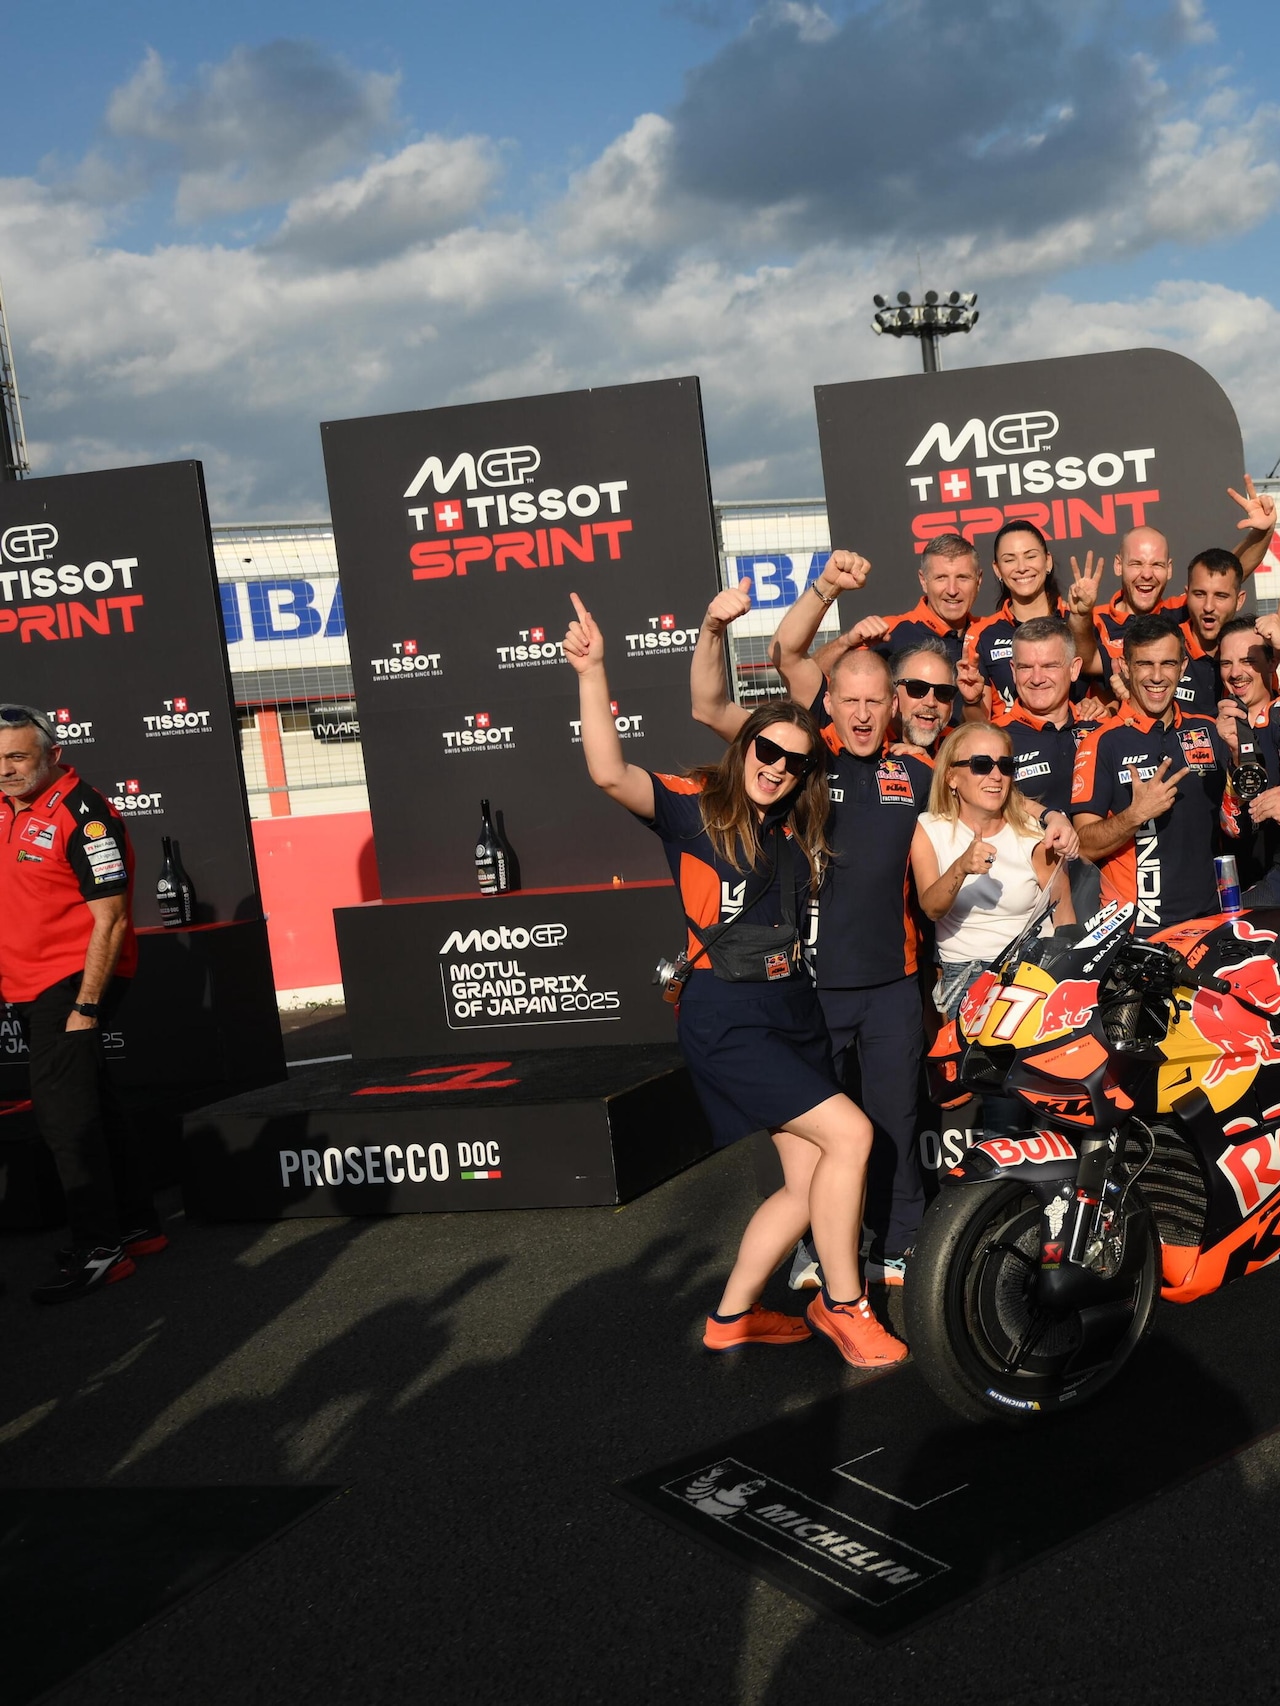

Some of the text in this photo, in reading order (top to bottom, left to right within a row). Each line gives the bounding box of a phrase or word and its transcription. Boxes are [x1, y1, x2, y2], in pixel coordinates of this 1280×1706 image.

[975, 448, 1156, 498] TISSOT
[466, 480, 628, 528] TISSOT
[911, 490, 1160, 554] SPRINT
[0, 522, 59, 563] GP
[409, 519, 633, 581] SPRINT
[497, 641, 566, 662] TISSOT
[625, 628, 699, 650] TISSOT
[371, 653, 441, 674] TISSOT
[56, 722, 93, 740] SOT
[143, 711, 210, 731] TISSOT
[569, 715, 643, 735] TOT
[442, 727, 513, 747] TISSOT
[107, 793, 162, 810] SSOT
[1084, 900, 1118, 933] WRS
[439, 922, 568, 955] MotoGP
[1092, 920, 1118, 942] Mobil
[1093, 934, 1122, 963] BAJAJ
[1187, 943, 1210, 970] KTM
[450, 960, 526, 981] MOTUL
[451, 974, 589, 1000] GRAND PRIX
[454, 991, 621, 1018] OF JAPAN 2025
[101, 1031, 125, 1049] 25
[350, 1061, 523, 1096] 2
[979, 1130, 1077, 1167] Bull
[279, 1140, 501, 1188] PROSECCO DOC
[989, 1390, 1027, 1409] MICHELIN
[756, 1503, 922, 1585] MICHELIN
